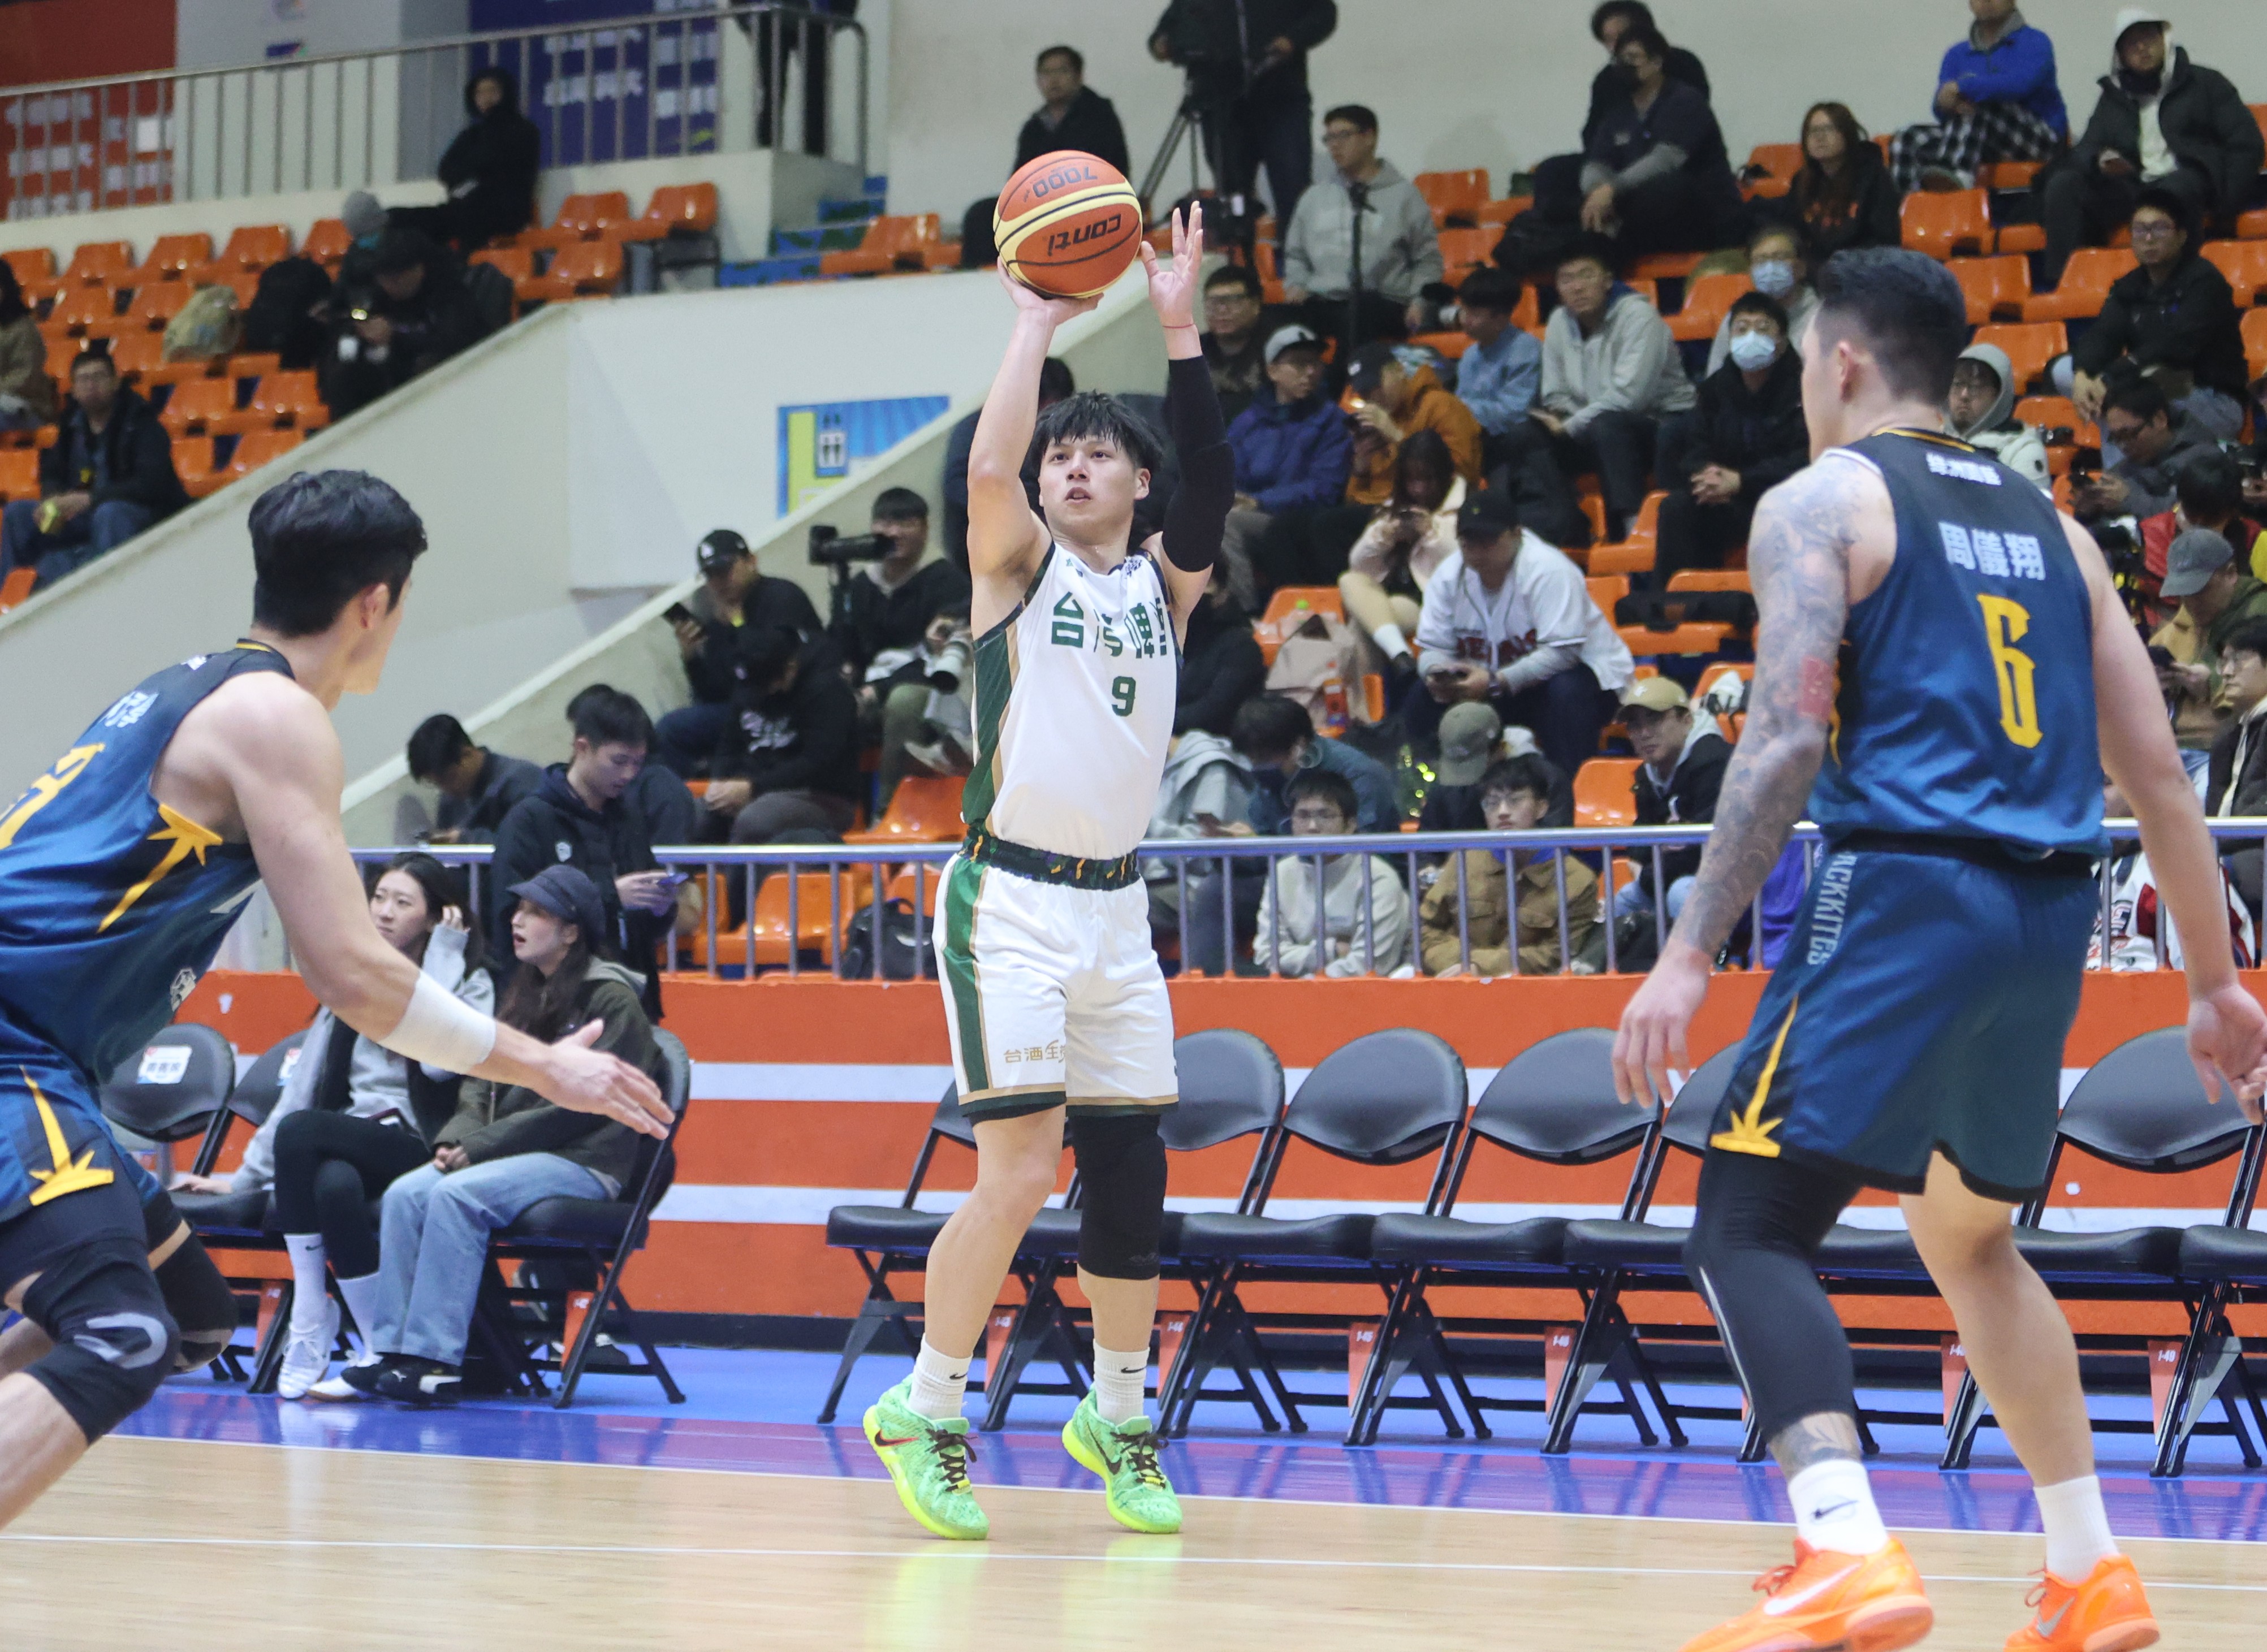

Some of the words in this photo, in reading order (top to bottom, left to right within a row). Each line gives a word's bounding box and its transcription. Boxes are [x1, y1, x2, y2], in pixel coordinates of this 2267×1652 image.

[1033, 166, 1098, 198] 7000
[1047, 213, 1122, 257] conti
[1976, 592, 2043, 749] 6
[1111, 676, 1137, 717] 9
